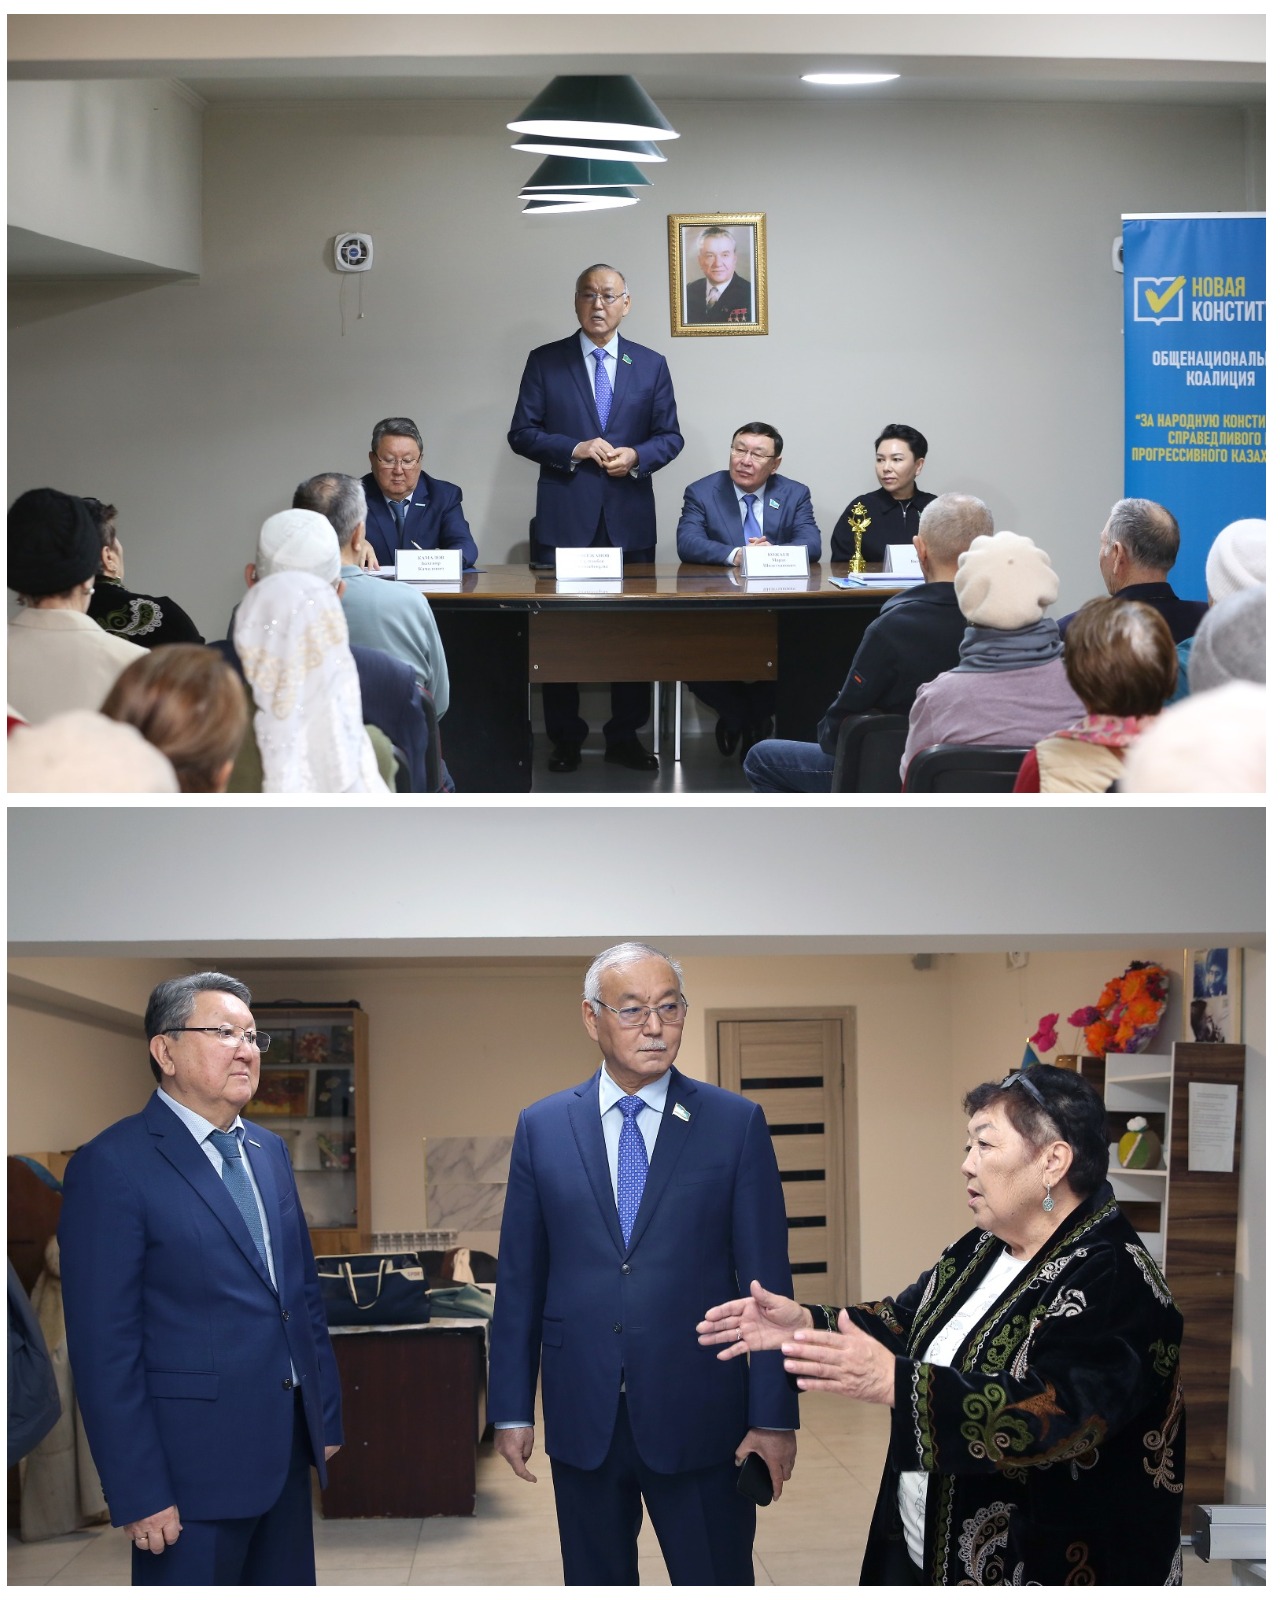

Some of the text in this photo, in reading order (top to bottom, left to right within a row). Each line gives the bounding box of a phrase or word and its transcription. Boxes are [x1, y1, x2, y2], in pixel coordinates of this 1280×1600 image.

[1192, 277, 1245, 297] НОВАЯ
[1192, 300, 1266, 322] КОНСТИТ
[1186, 370, 1256, 389] КОАЛИЦИЯ
[1135, 414, 1154, 427] “ЗА
[1157, 414, 1219, 430] НАРОДНУЮ
[1168, 431, 1262, 447] СПРАВЕДЛИВОГО
[1132, 448, 1228, 463] ПРОГРЕССИВНОГО
